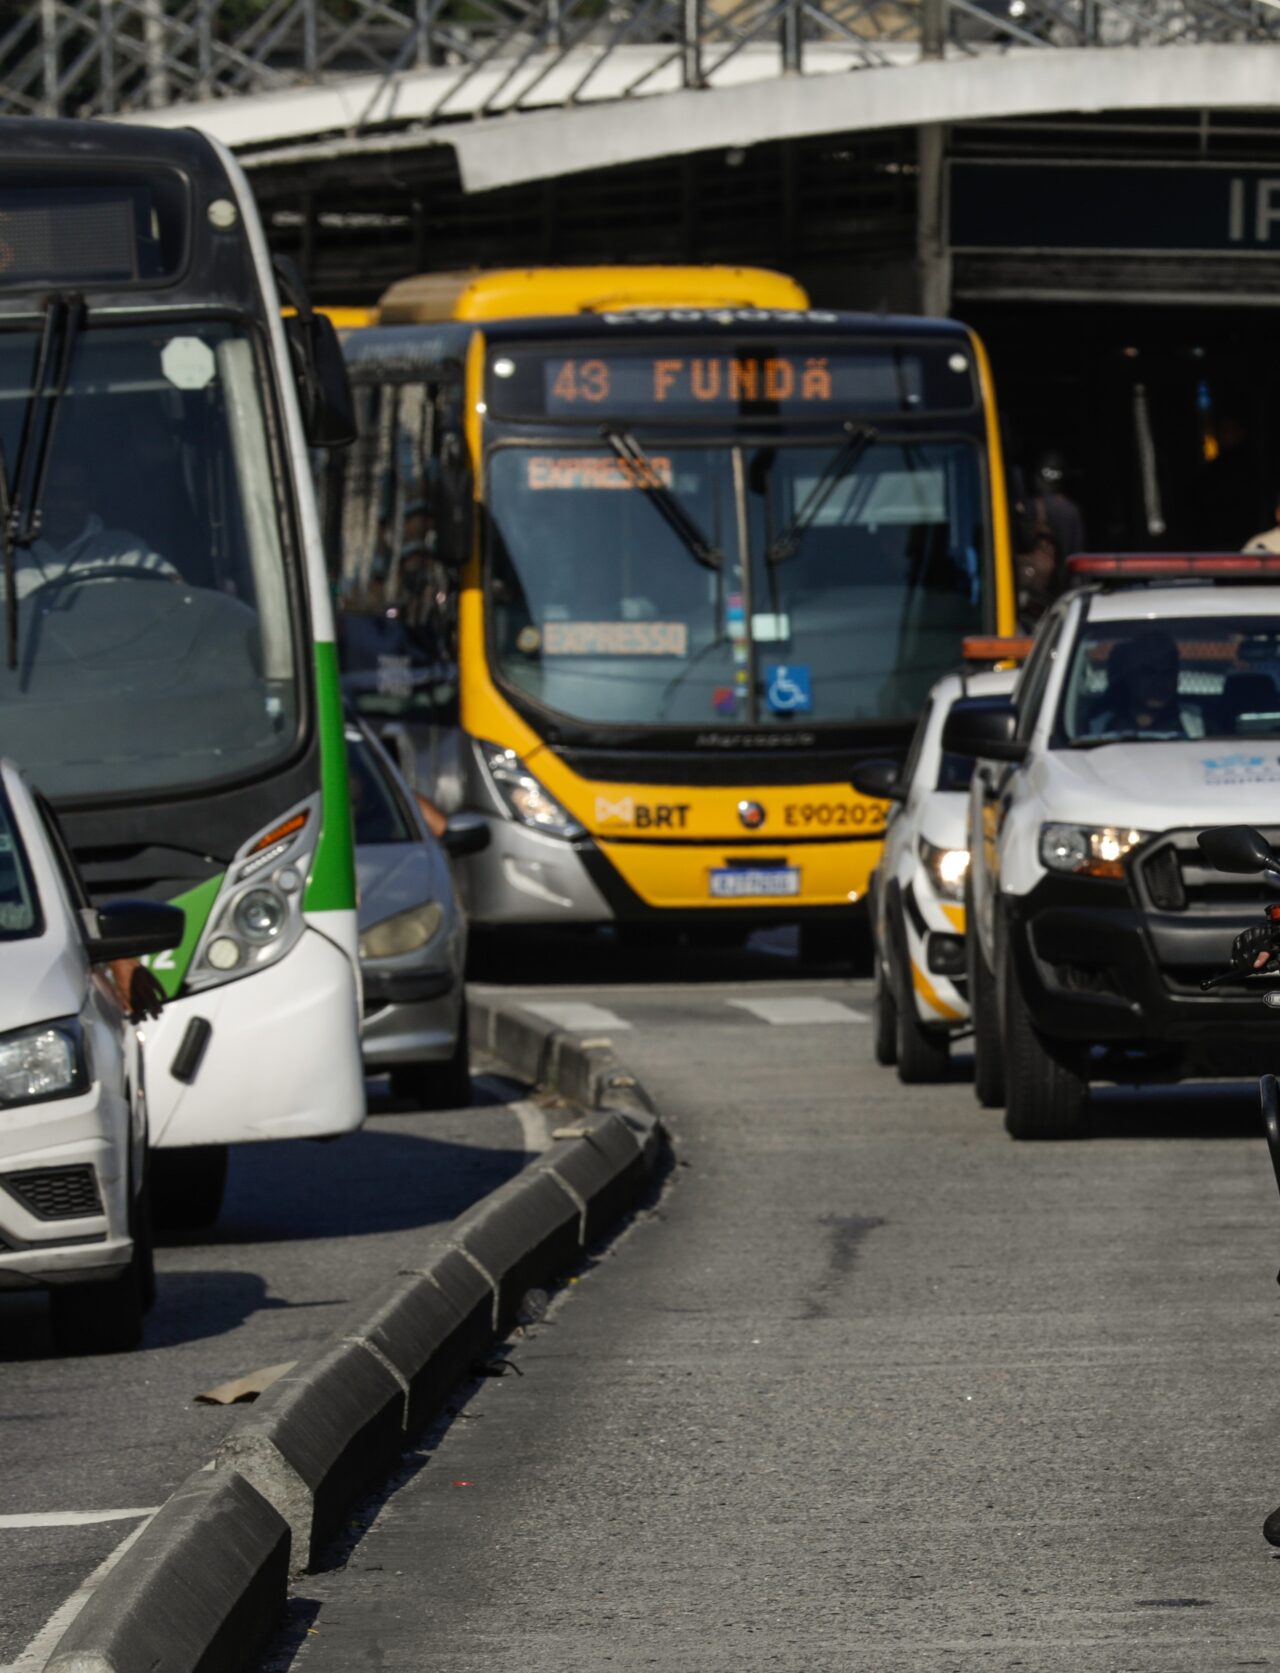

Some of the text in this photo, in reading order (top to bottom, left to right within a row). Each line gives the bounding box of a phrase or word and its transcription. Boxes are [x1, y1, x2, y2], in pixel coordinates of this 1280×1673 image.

[551, 360, 611, 403] 43
[634, 803, 888, 828] BRT E90202
